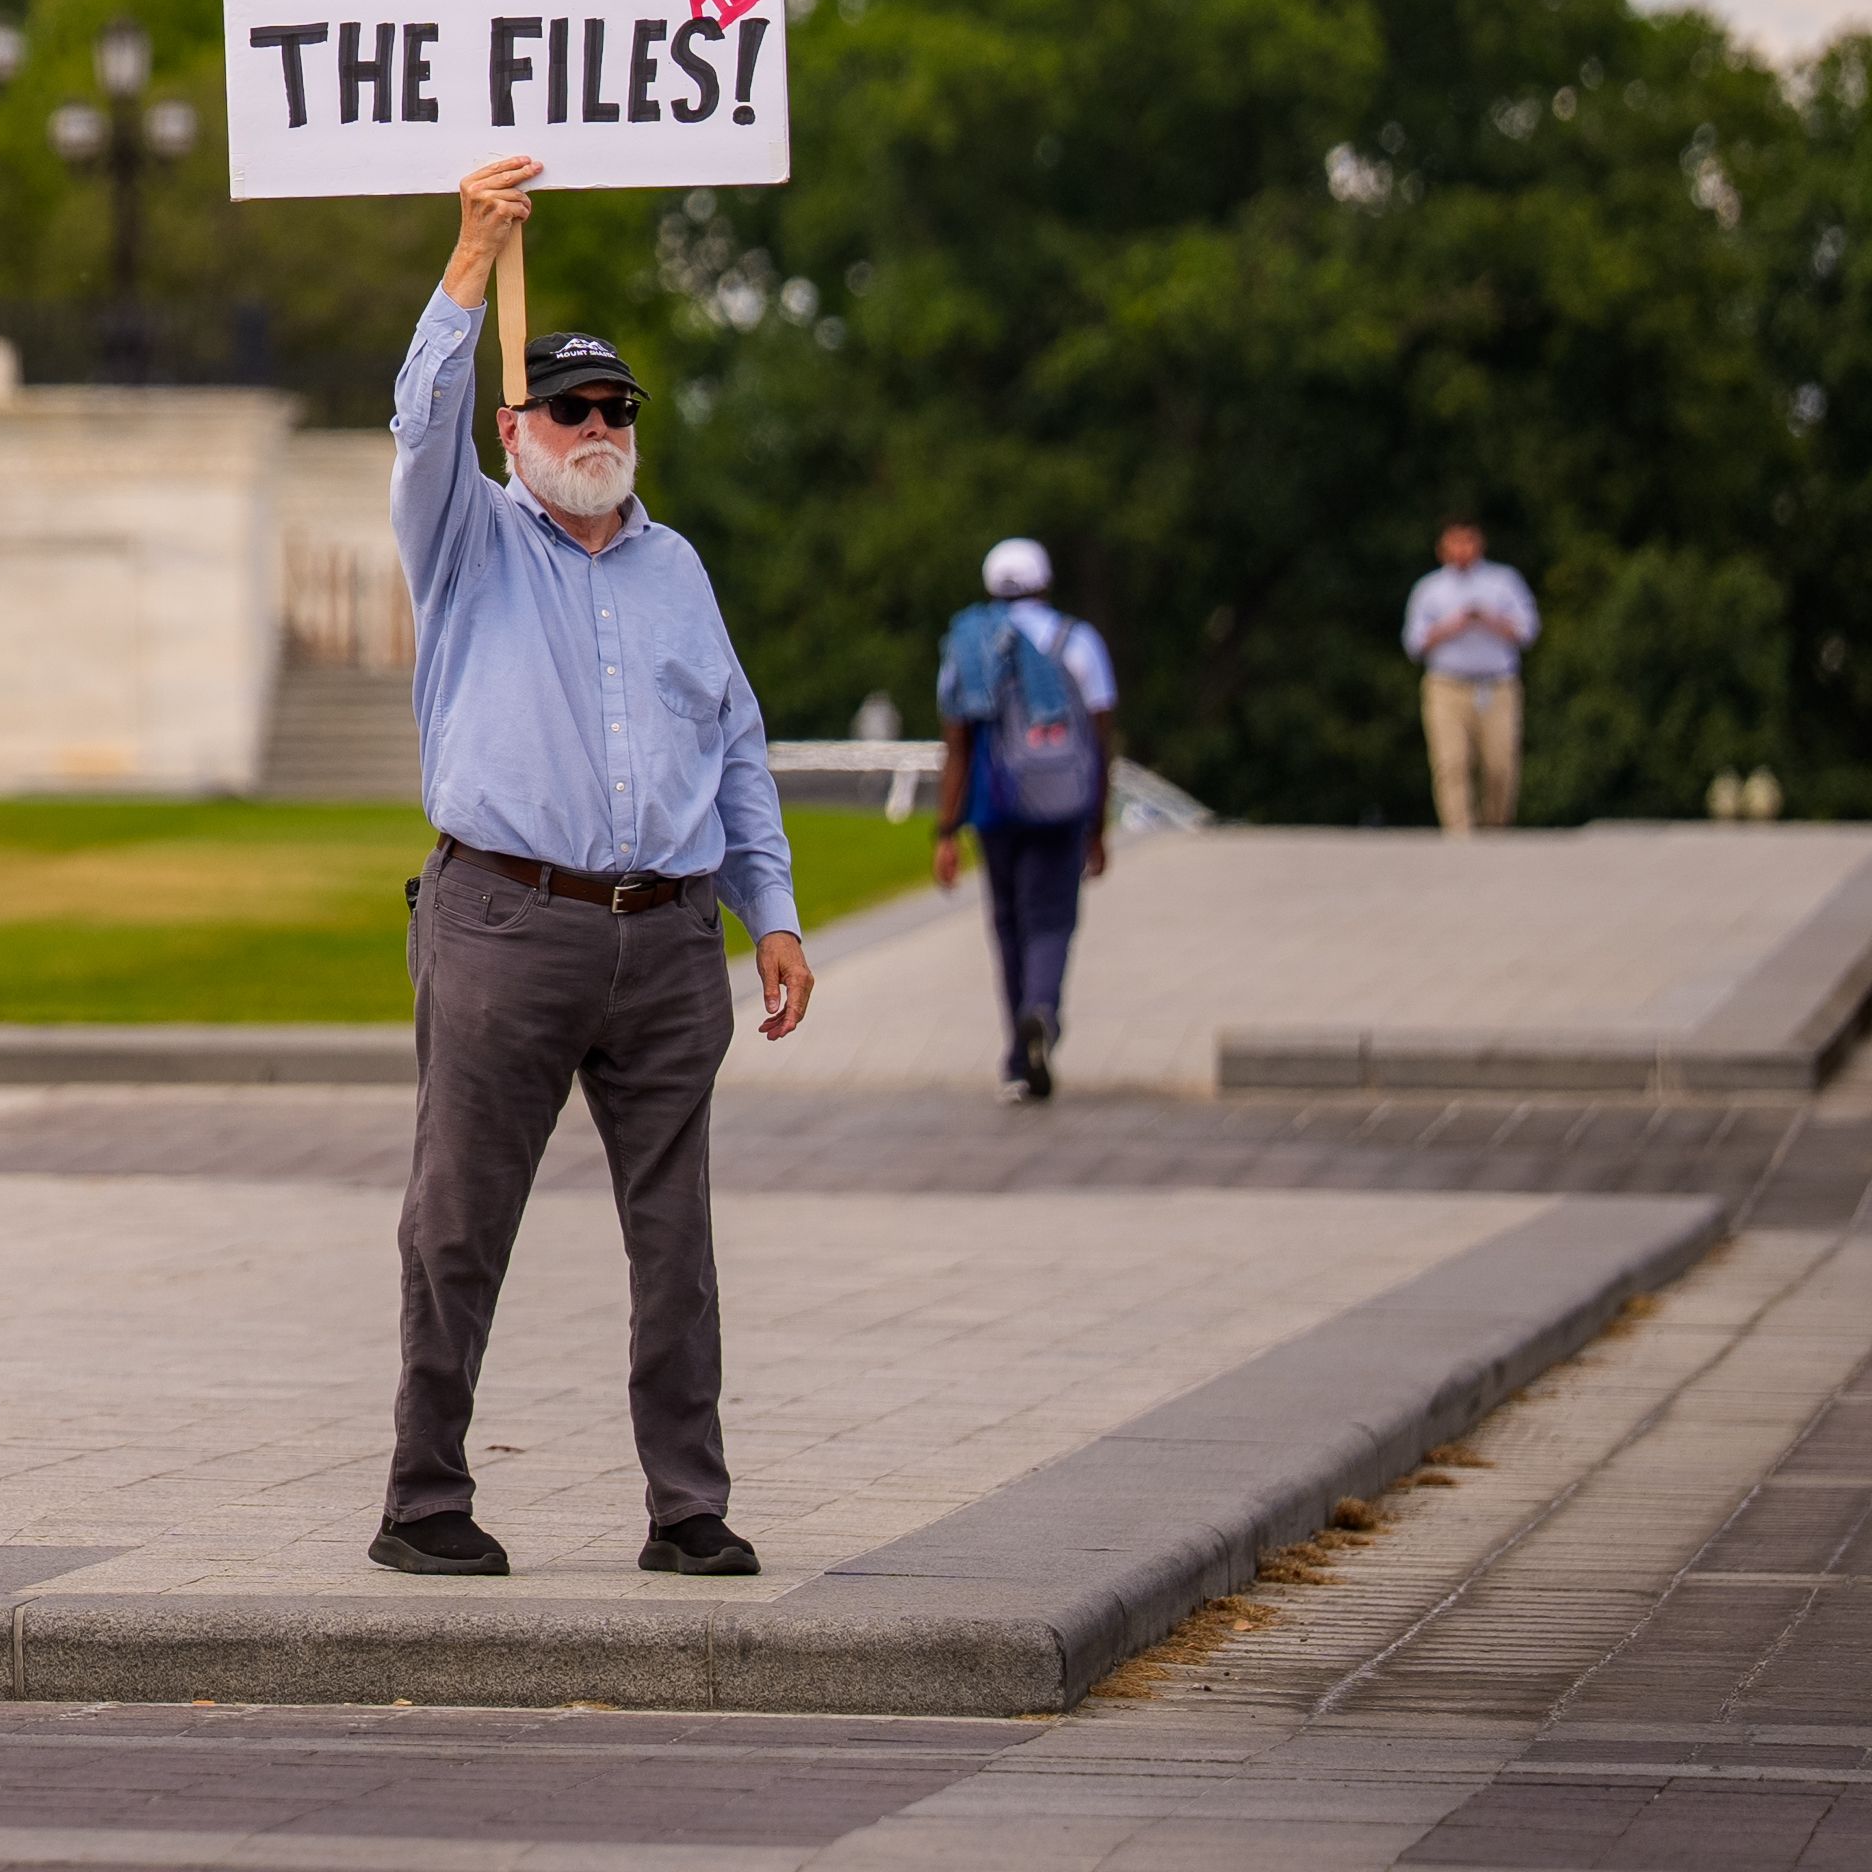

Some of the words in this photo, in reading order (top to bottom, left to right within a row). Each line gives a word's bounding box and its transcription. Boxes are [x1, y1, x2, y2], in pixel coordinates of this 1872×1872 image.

[249, 21, 440, 129] THE
[489, 15, 770, 126] FILES!
[556, 349, 588, 359] MOUNT
